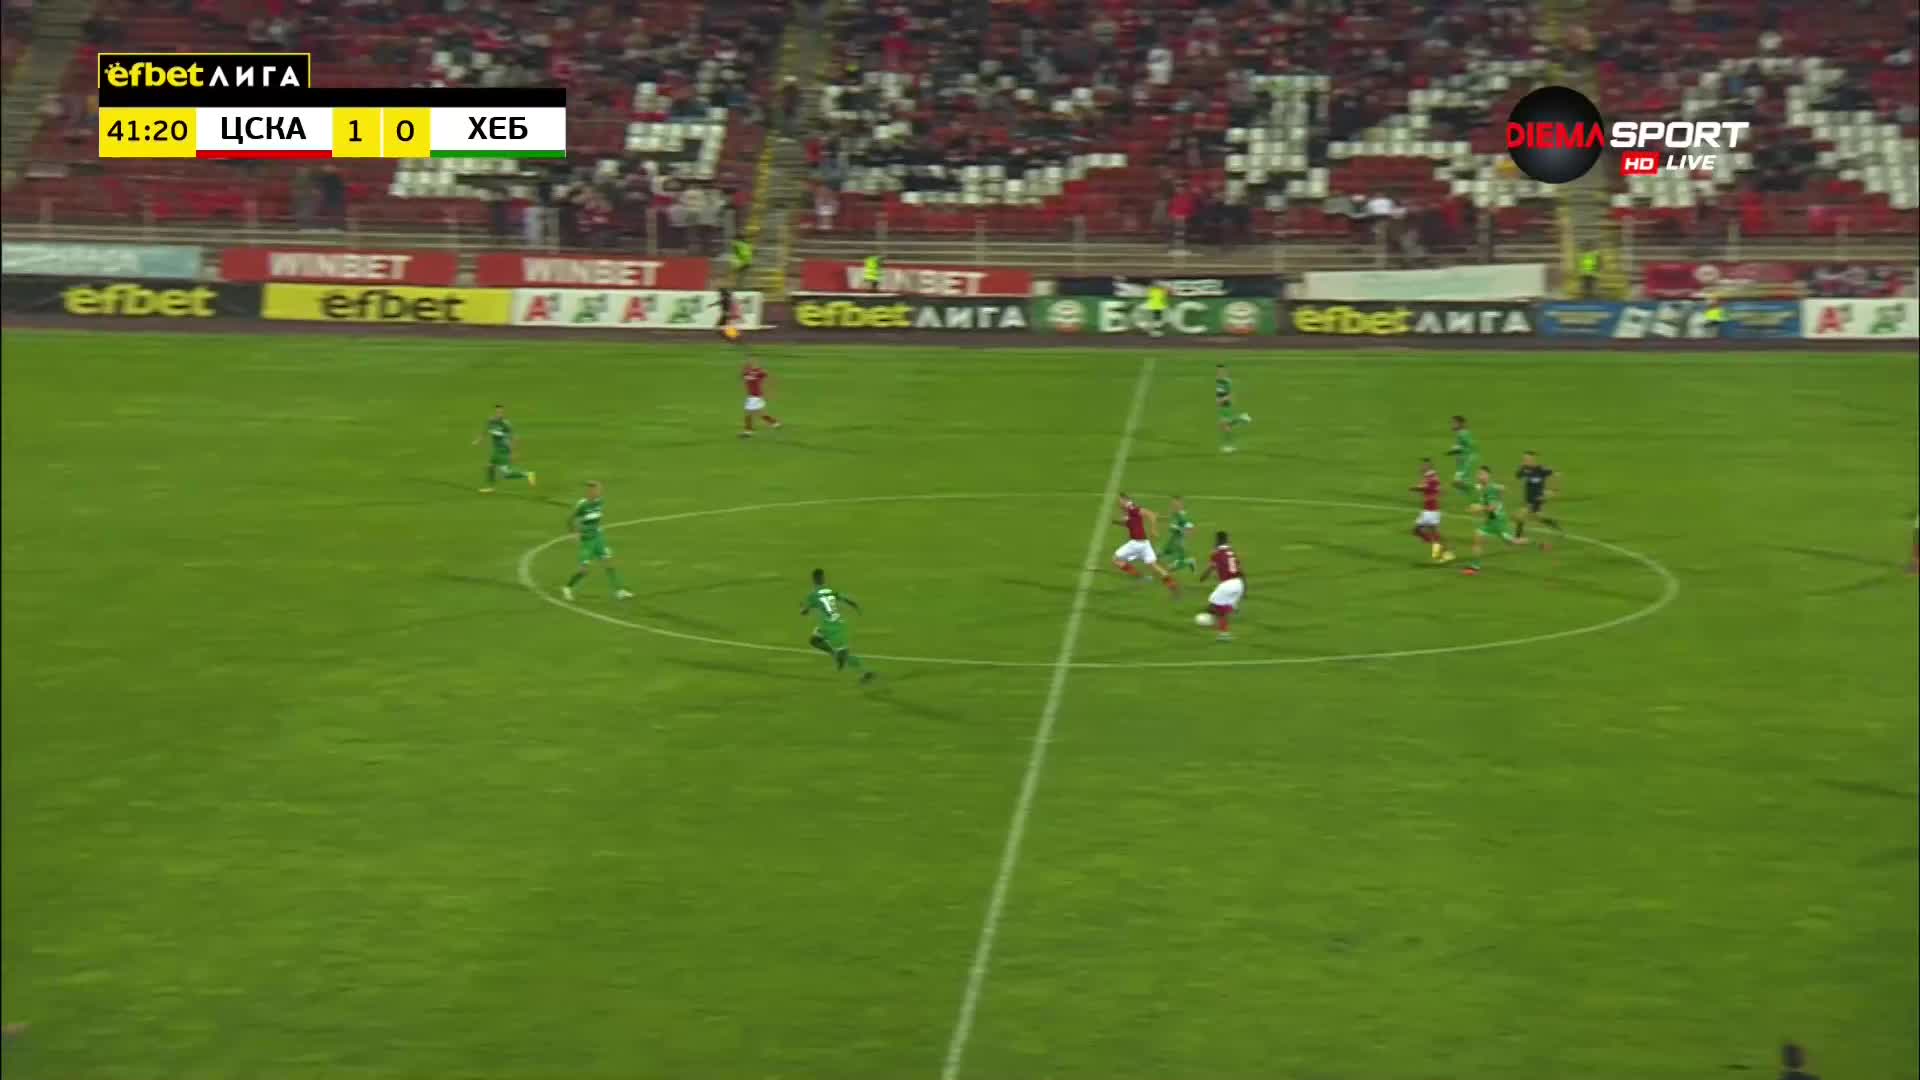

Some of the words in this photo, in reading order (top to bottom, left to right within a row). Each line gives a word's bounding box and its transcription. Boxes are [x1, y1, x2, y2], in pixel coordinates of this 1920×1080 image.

[63, 283, 218, 318] efbet
[319, 289, 465, 322] efbet
[795, 300, 912, 329] efbet
[1294, 305, 1412, 335] efbet
